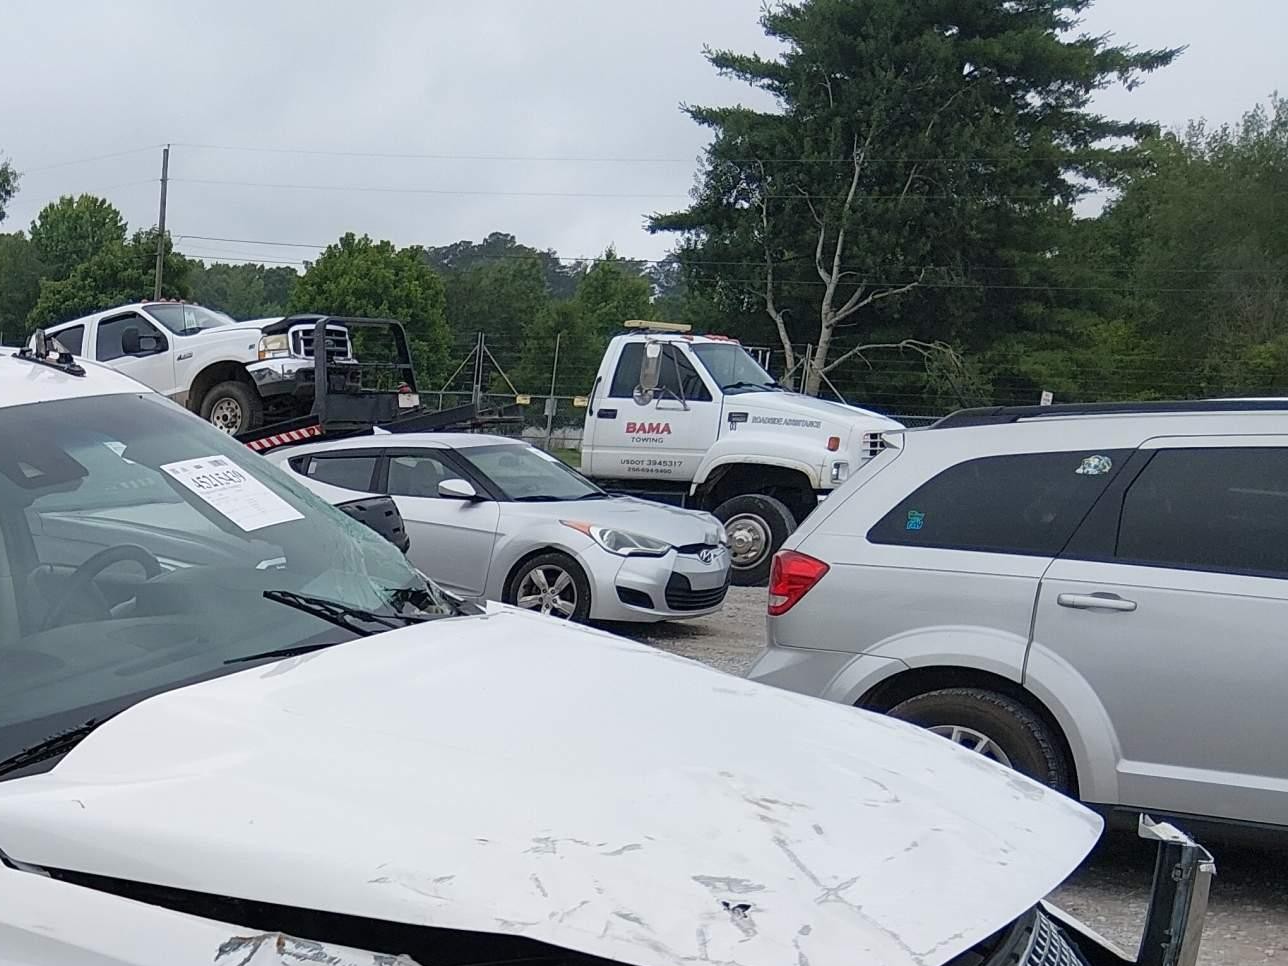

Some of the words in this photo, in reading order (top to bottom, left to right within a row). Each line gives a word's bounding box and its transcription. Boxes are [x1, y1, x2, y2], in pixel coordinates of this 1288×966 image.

[625, 421, 672, 434] BAMA
[631, 436, 664, 444] TOWING
[620, 458, 644, 466] USDOT
